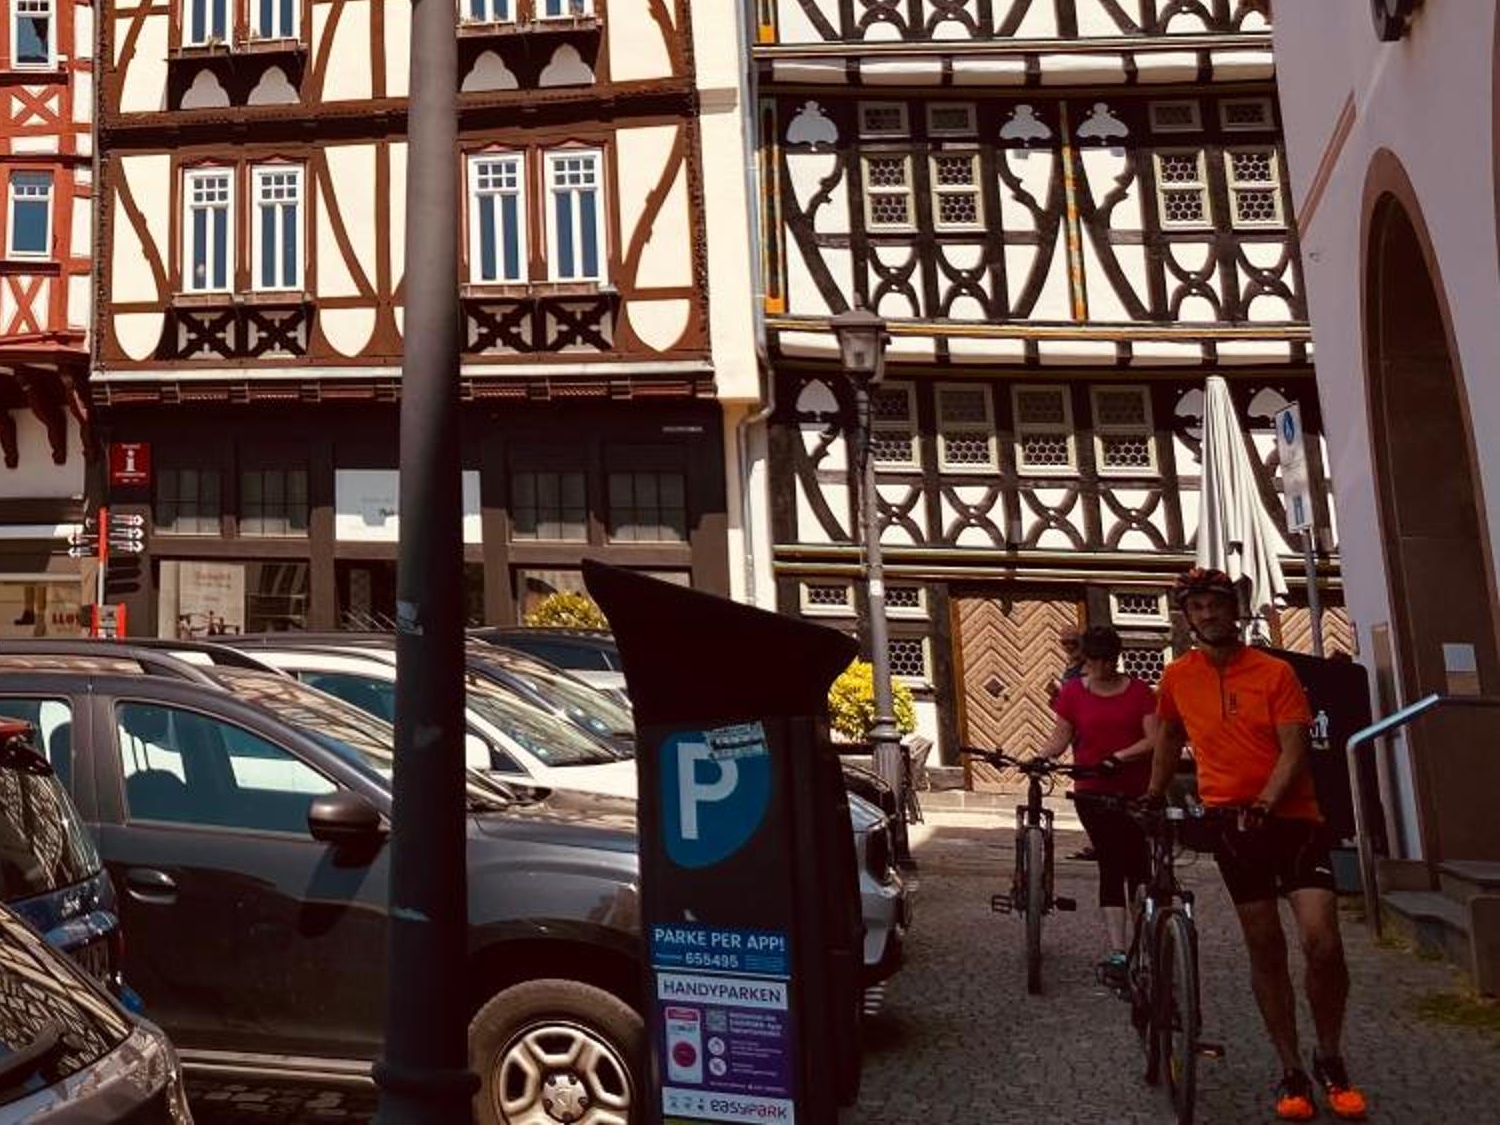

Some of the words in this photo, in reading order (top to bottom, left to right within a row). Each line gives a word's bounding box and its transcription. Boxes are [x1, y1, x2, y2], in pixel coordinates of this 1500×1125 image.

[677, 742, 739, 840] P
[655, 928, 707, 946] PARKE
[711, 932, 741, 948] PER
[747, 935, 785, 952] APP!
[663, 980, 781, 1003] HANDYPARKEN
